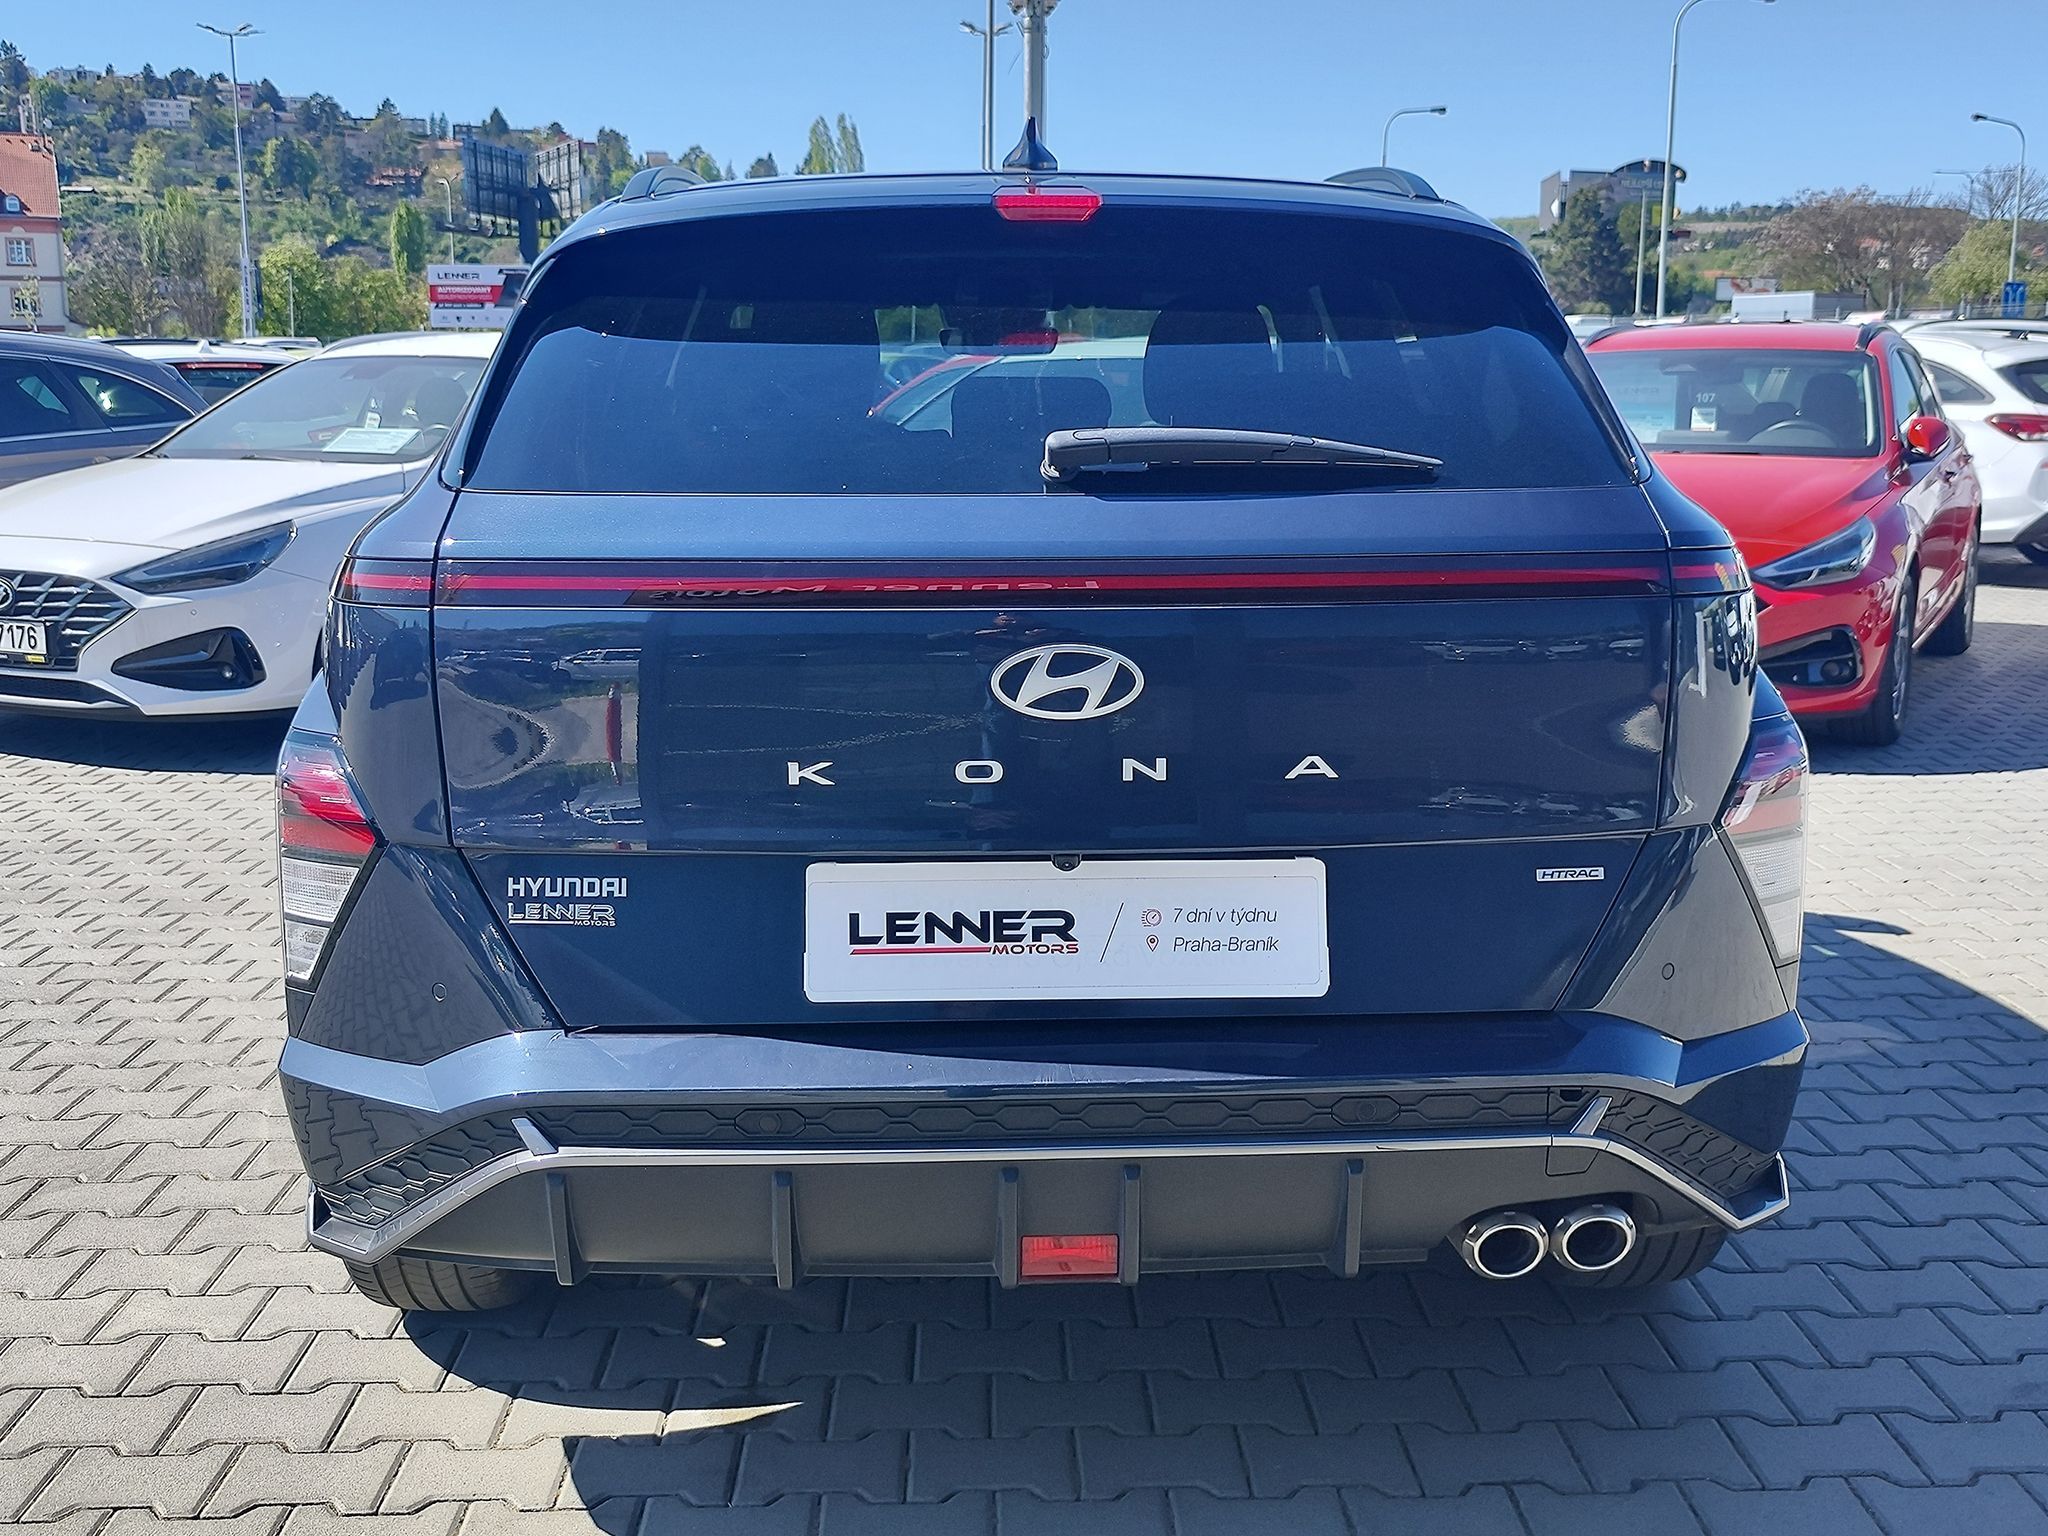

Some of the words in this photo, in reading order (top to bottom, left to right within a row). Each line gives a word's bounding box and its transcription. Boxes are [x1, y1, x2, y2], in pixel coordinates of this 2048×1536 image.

[1695, 392, 1716, 404] 107
[787, 755, 1340, 786] KONA
[1540, 868, 1600, 880] HTRAC
[507, 877, 627, 898] HYUNDAI
[507, 902, 616, 920] LENNER
[1173, 907, 1184, 923] 7
[1186, 907, 1214, 923] dní
[1216, 911, 1227, 922] v
[1230, 907, 1278, 927] týdnu
[574, 919, 616, 927] MOTORS
[849, 910, 1079, 945] LENNER
[991, 943, 1080, 955] MOTORS
[1173, 936, 1280, 952] Praha-Braník
